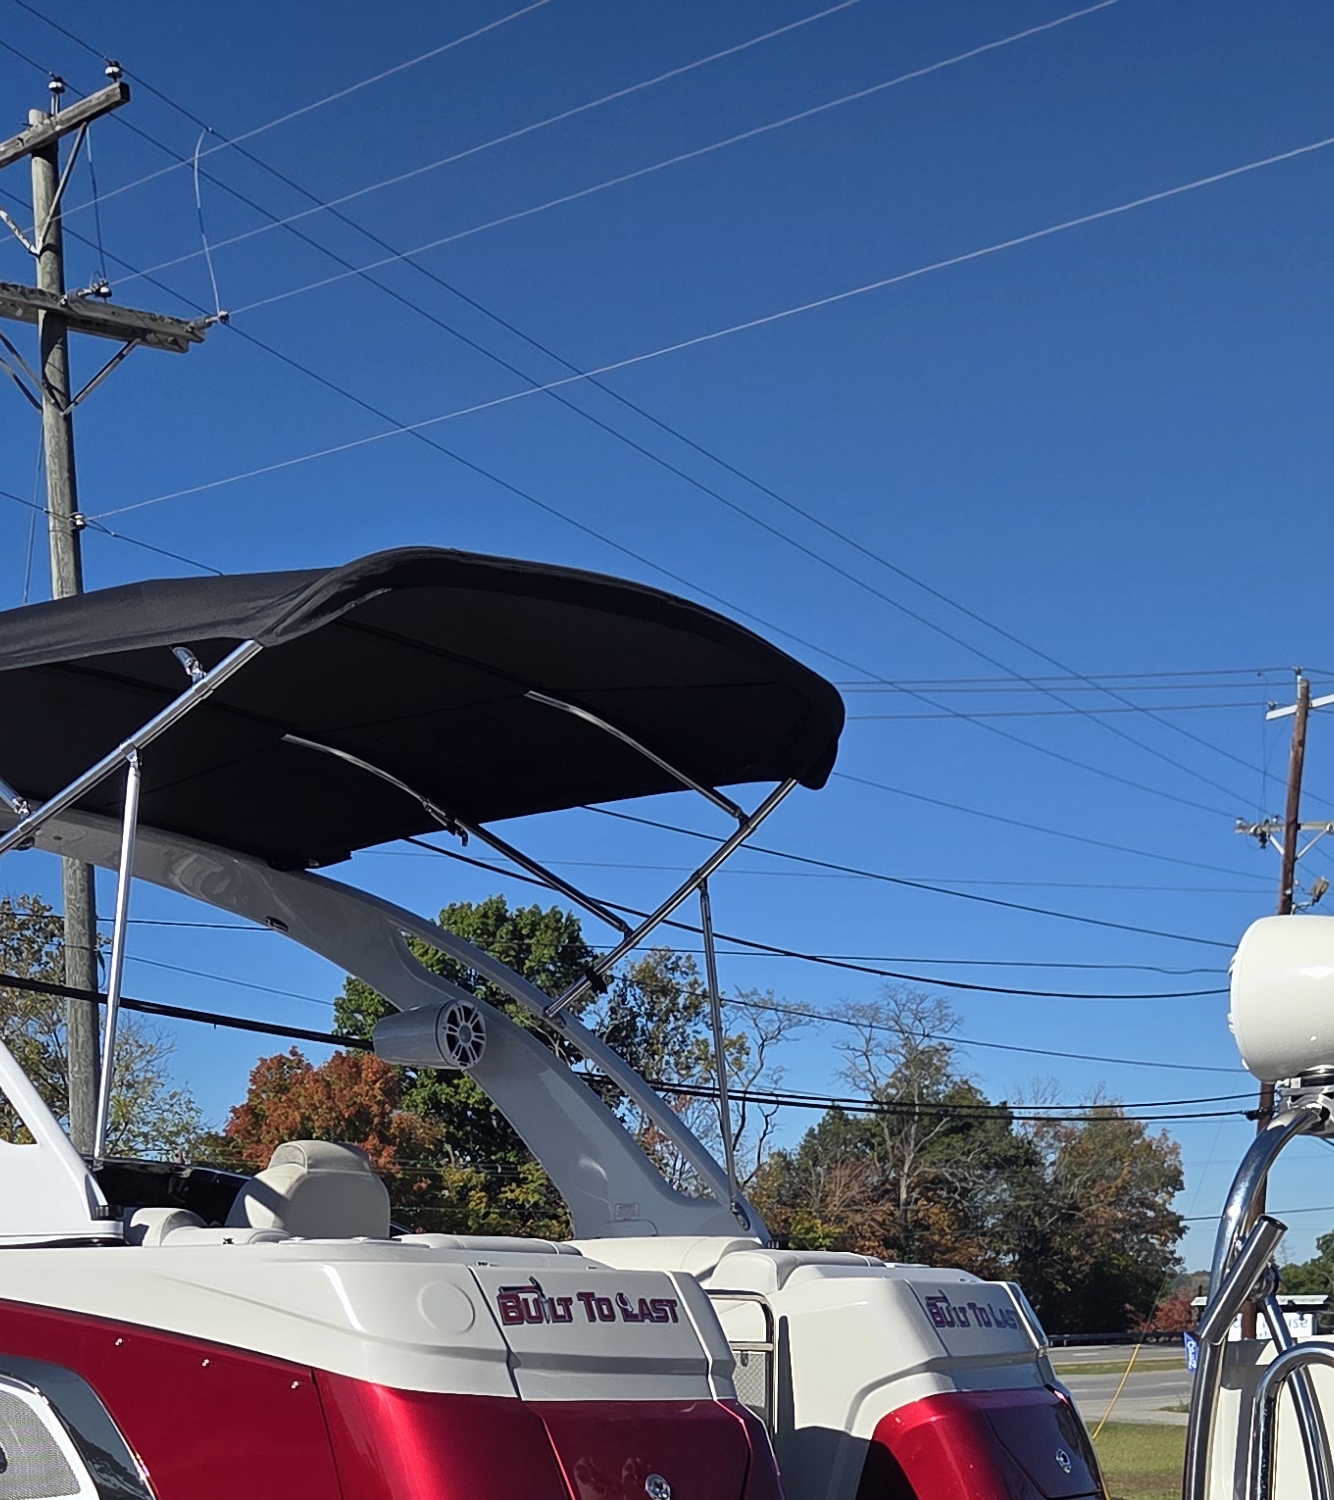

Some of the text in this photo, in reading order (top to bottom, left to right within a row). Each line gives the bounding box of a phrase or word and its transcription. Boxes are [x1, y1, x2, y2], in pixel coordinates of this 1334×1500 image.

[497, 1290, 679, 1326] BUILT TO LAST
